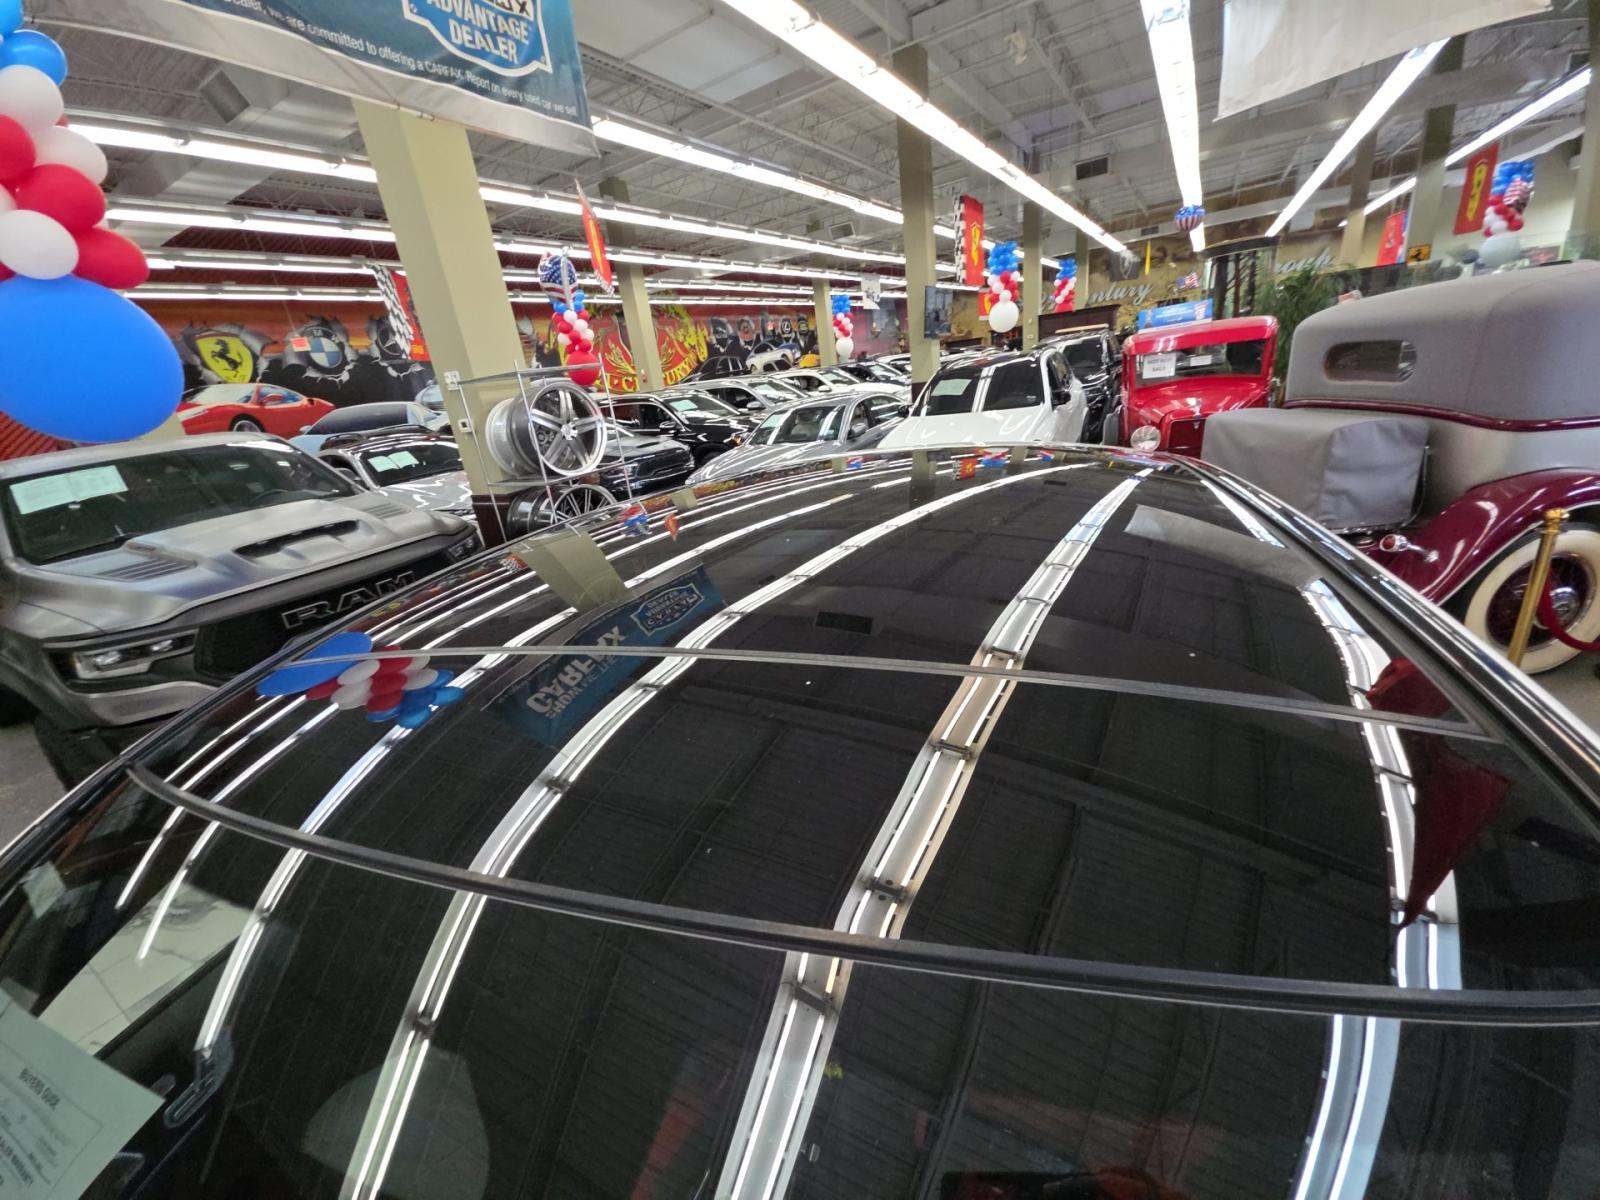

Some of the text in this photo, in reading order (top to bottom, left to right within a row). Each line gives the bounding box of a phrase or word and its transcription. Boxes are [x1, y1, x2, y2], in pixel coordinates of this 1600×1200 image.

[427, 0, 530, 45] DVANTAGE
[449, 18, 520, 65] DEALER
[307, 24, 365, 52] committed
[366, 41, 378, 56] to
[378, 46, 416, 71] offering
[416, 60, 425, 71] a
[465, 70, 491, 93] Report
[490, 83, 501, 94] on
[281, 570, 414, 629] RAM
